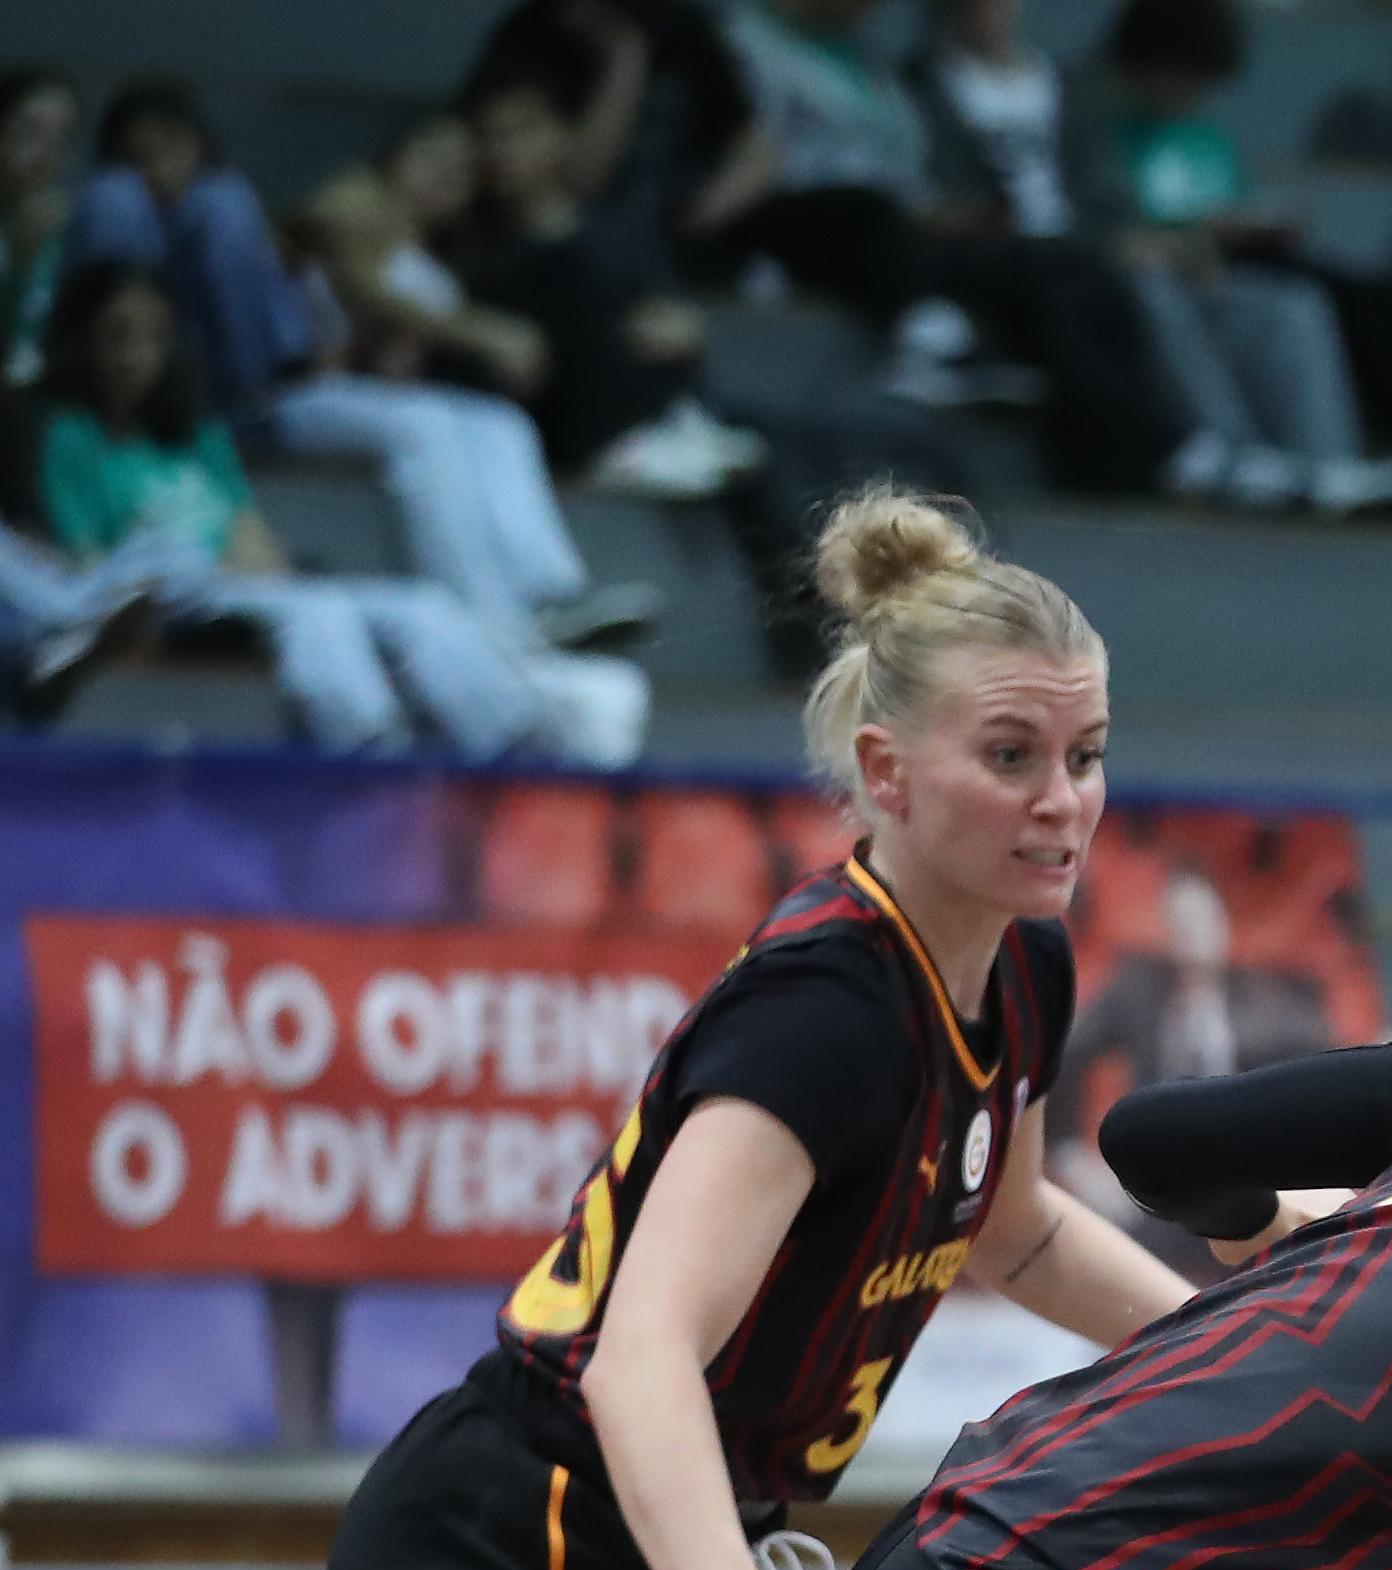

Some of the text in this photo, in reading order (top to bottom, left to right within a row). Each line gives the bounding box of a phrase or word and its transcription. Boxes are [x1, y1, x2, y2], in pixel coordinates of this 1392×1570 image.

[86, 932, 337, 1093] NÃO
[90, 1103, 640, 1234] O ADVERS
